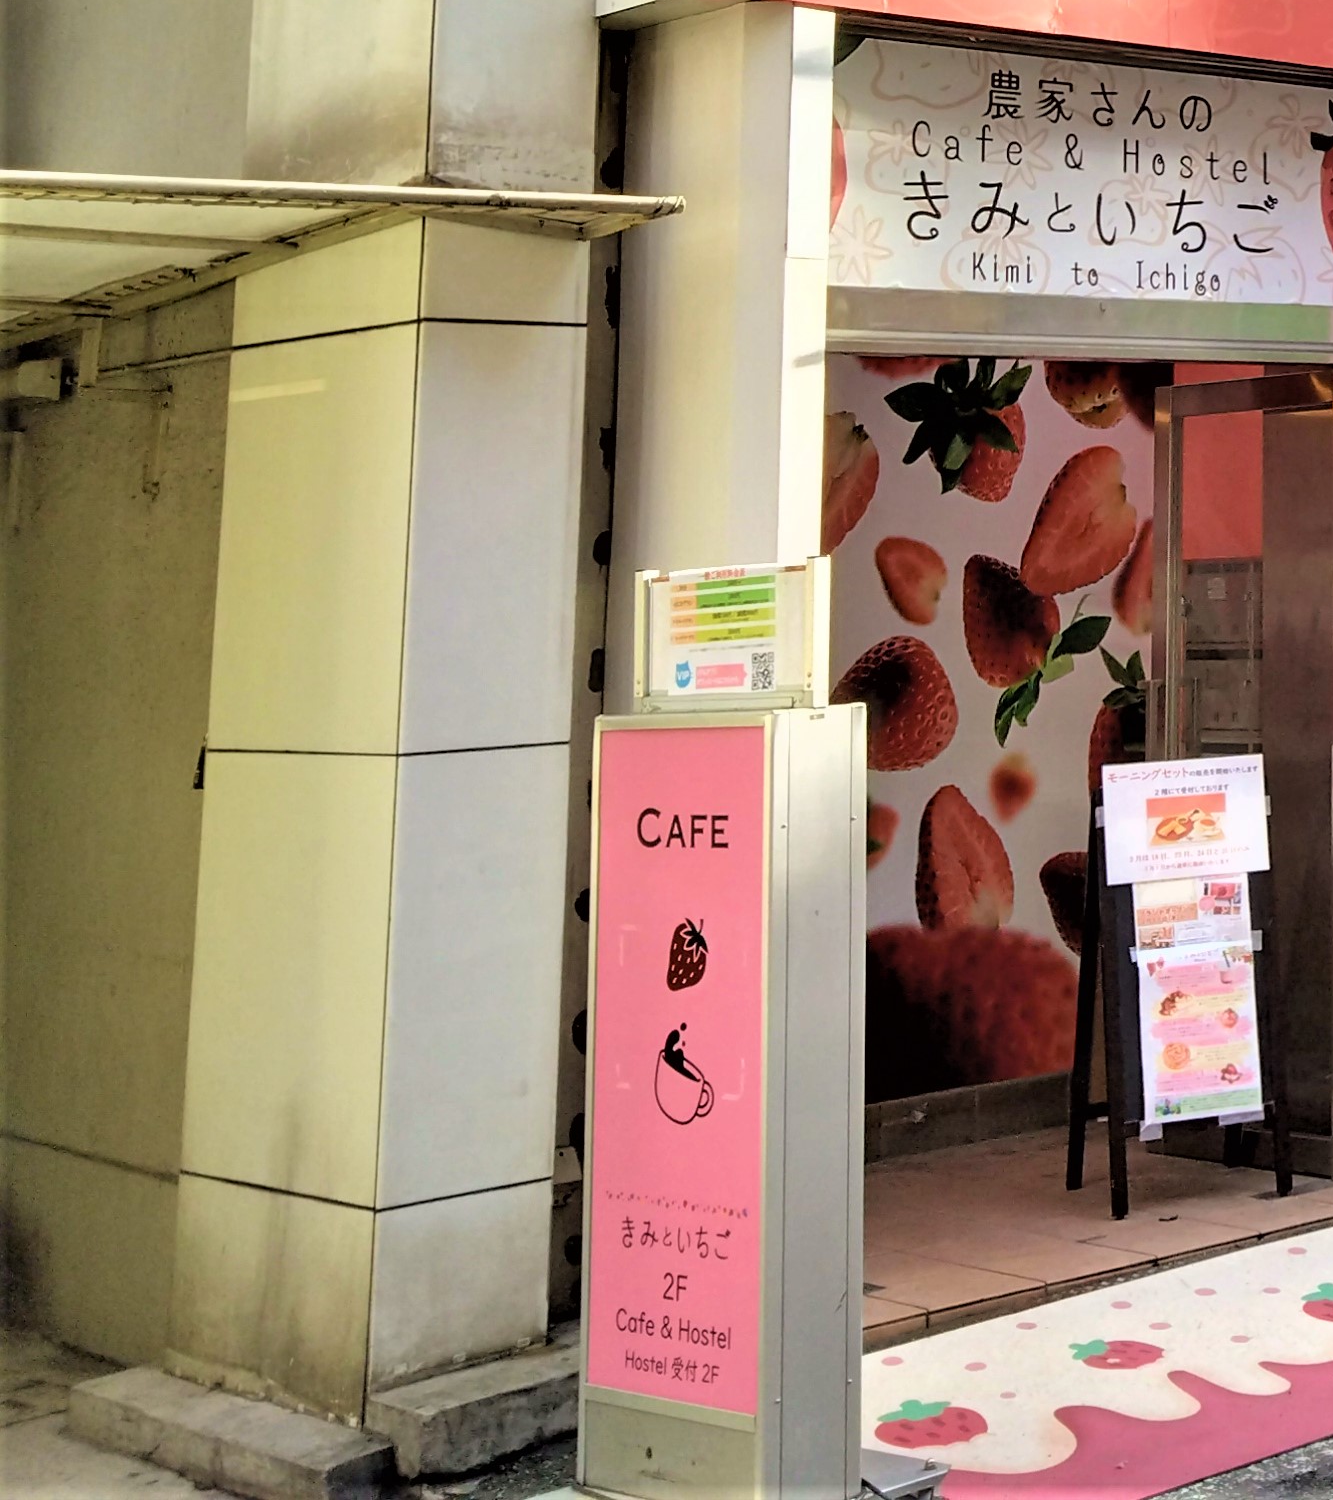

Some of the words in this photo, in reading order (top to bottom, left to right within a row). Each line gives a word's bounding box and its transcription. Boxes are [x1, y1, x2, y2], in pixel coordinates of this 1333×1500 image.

[982, 69, 1213, 132] 農家さんの
[911, 120, 1024, 167] Cafe
[1064, 133, 1084, 171] &
[1123, 138, 1272, 186] Hostel
[903, 170, 1279, 254] きみといちご
[972, 253, 1034, 285] Kimi
[1071, 260, 1100, 288] to
[1136, 259, 1222, 297] Ichigo
[637, 807, 729, 848] CAFE
[621, 1216, 731, 1260] きみといちご
[662, 1272, 688, 1302] 2F
[615, 1308, 655, 1337] Cafe
[660, 1315, 673, 1340] &
[678, 1317, 732, 1350] Hostel
[624, 1349, 667, 1376] Hostel
[671, 1356, 698, 1383] 受付
[701, 1363, 720, 1385] 2F
